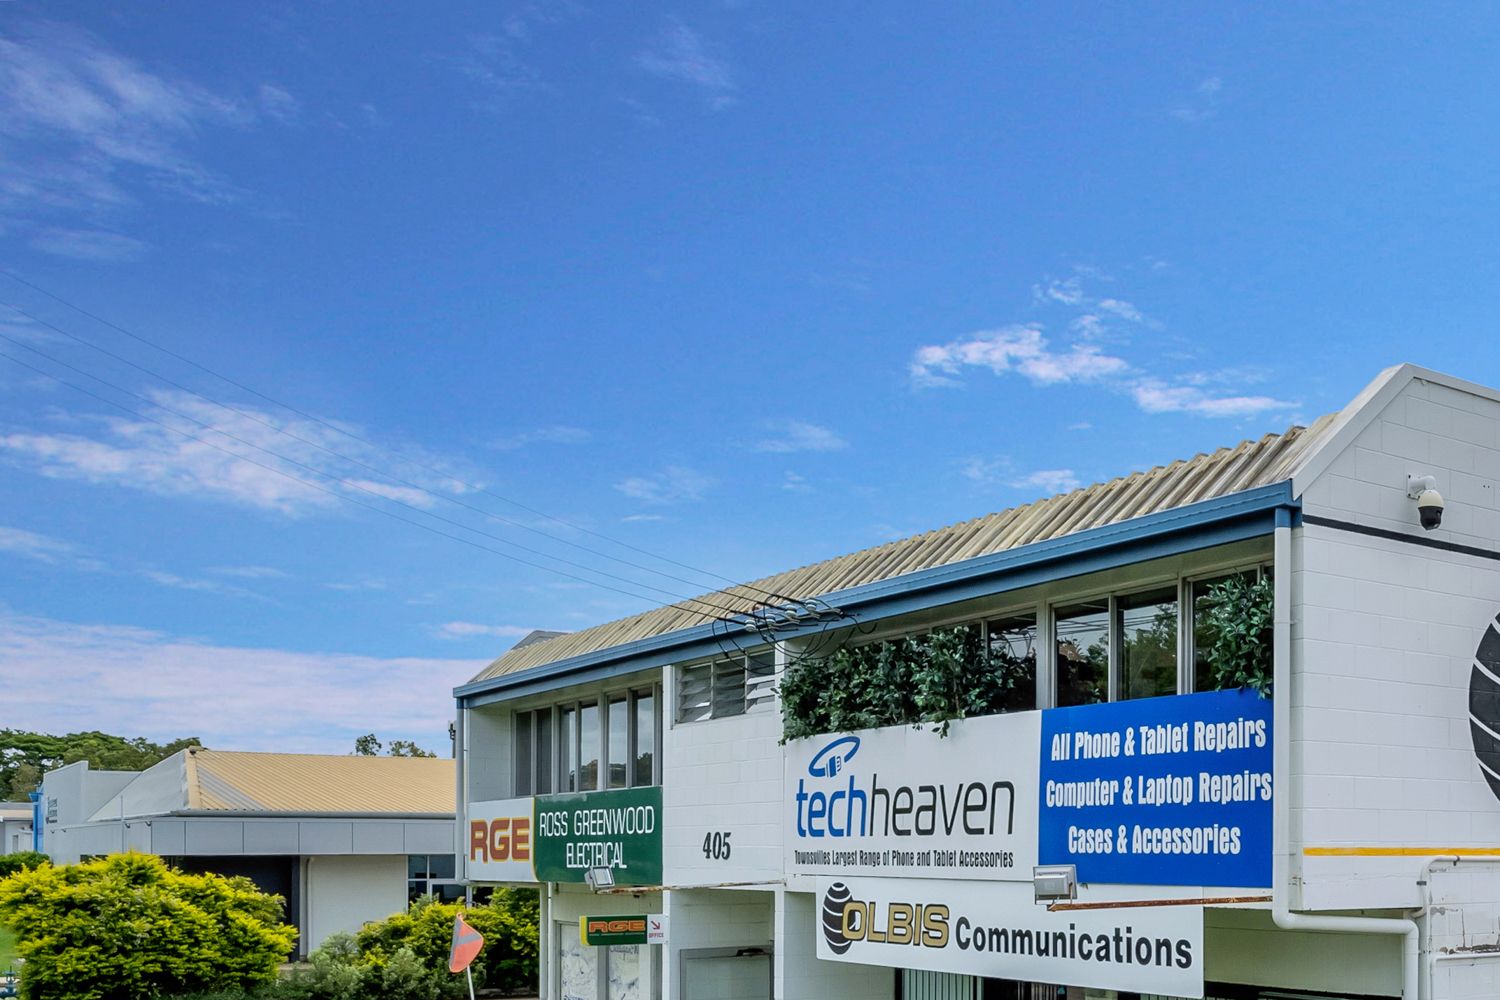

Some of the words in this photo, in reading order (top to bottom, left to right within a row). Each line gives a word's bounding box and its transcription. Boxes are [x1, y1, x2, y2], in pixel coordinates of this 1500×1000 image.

[1051, 733, 1071, 761] All
[1074, 731, 1120, 760] Phone
[1124, 727, 1135, 757] &
[1139, 722, 1189, 755] Tablet
[1194, 717, 1267, 753] Repairs
[1046, 776, 1119, 809] Computer
[1122, 775, 1133, 805] &
[1138, 773, 1193, 807] Laptop
[1199, 770, 1272, 805] Repairs
[539, 811, 568, 837] ROSS
[574, 805, 655, 836] GREENWOOD
[470, 816, 531, 864] RGE
[703, 831, 732, 860] 405
[1068, 825, 1113, 854] Cases
[1117, 825, 1127, 854] &
[1132, 824, 1241, 855] Accessories
[566, 842, 627, 869] ELECTRICAL
[794, 850, 831, 865] Townsvilles
[832, 850, 858, 867] Largest
[859, 850, 881, 867] Range
[883, 850, 890, 866] of
[891, 850, 914, 866] Phone
[917, 850, 931, 867] and
[933, 850, 957, 867] Tablet
[959, 850, 1014, 868] Accessories
[589, 920, 646, 933] RGE
[842, 900, 949, 949] OLBIS
[955, 916, 1193, 970] Communications
